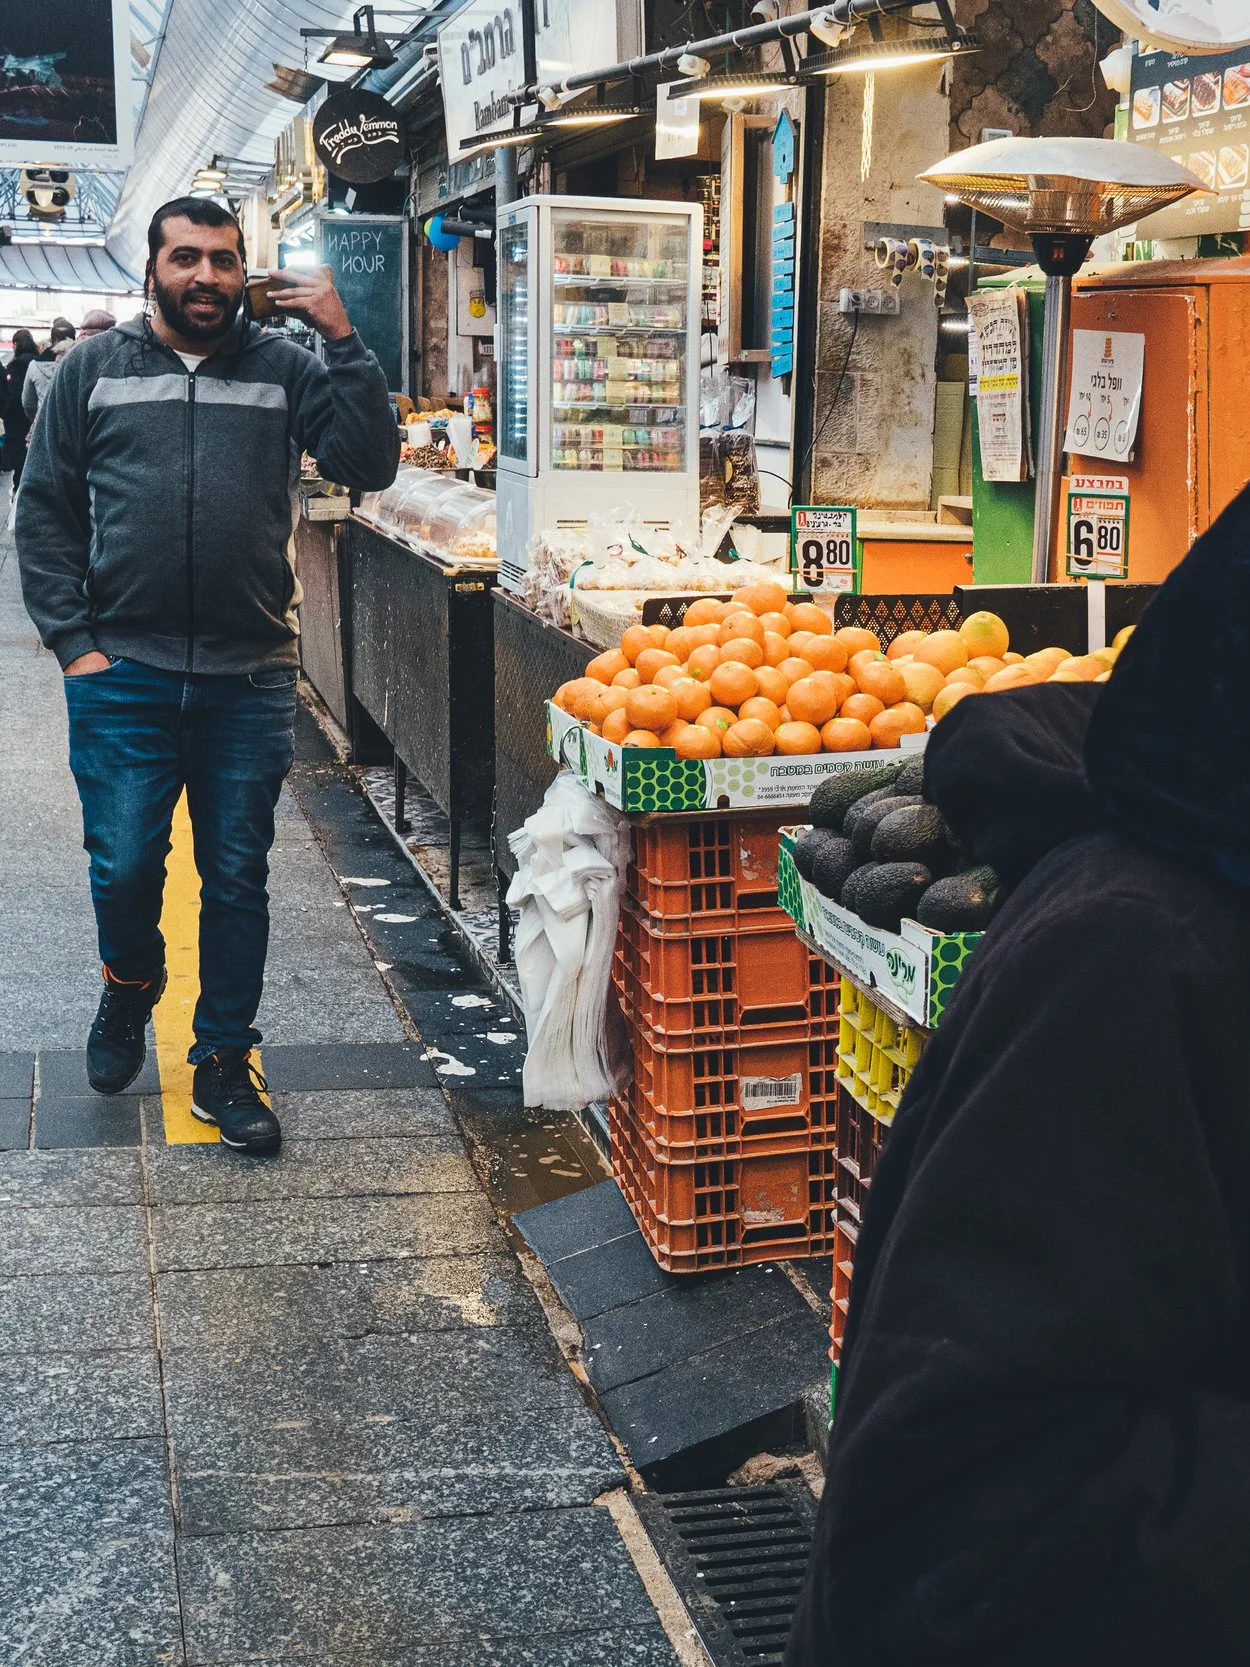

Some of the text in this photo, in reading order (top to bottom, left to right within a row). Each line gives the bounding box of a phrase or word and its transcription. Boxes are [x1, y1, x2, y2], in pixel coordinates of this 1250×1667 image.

[319, 118, 361, 152] Freddy
[328, 231, 382, 252] HAPPY
[342, 254, 385, 274] HOUR
[1090, 371, 1122, 391] וופל בלגי
[1075, 478, 1124, 490] במבצע
[1086, 500, 1124, 511] תפוזים
[1073, 519, 1121, 567] 6 80
[802, 540, 850, 588] 8 80
[770, 764, 814, 777] במטבח
[814, 761, 853, 774] קסמים
[886, 950, 916, 983] מרינה
